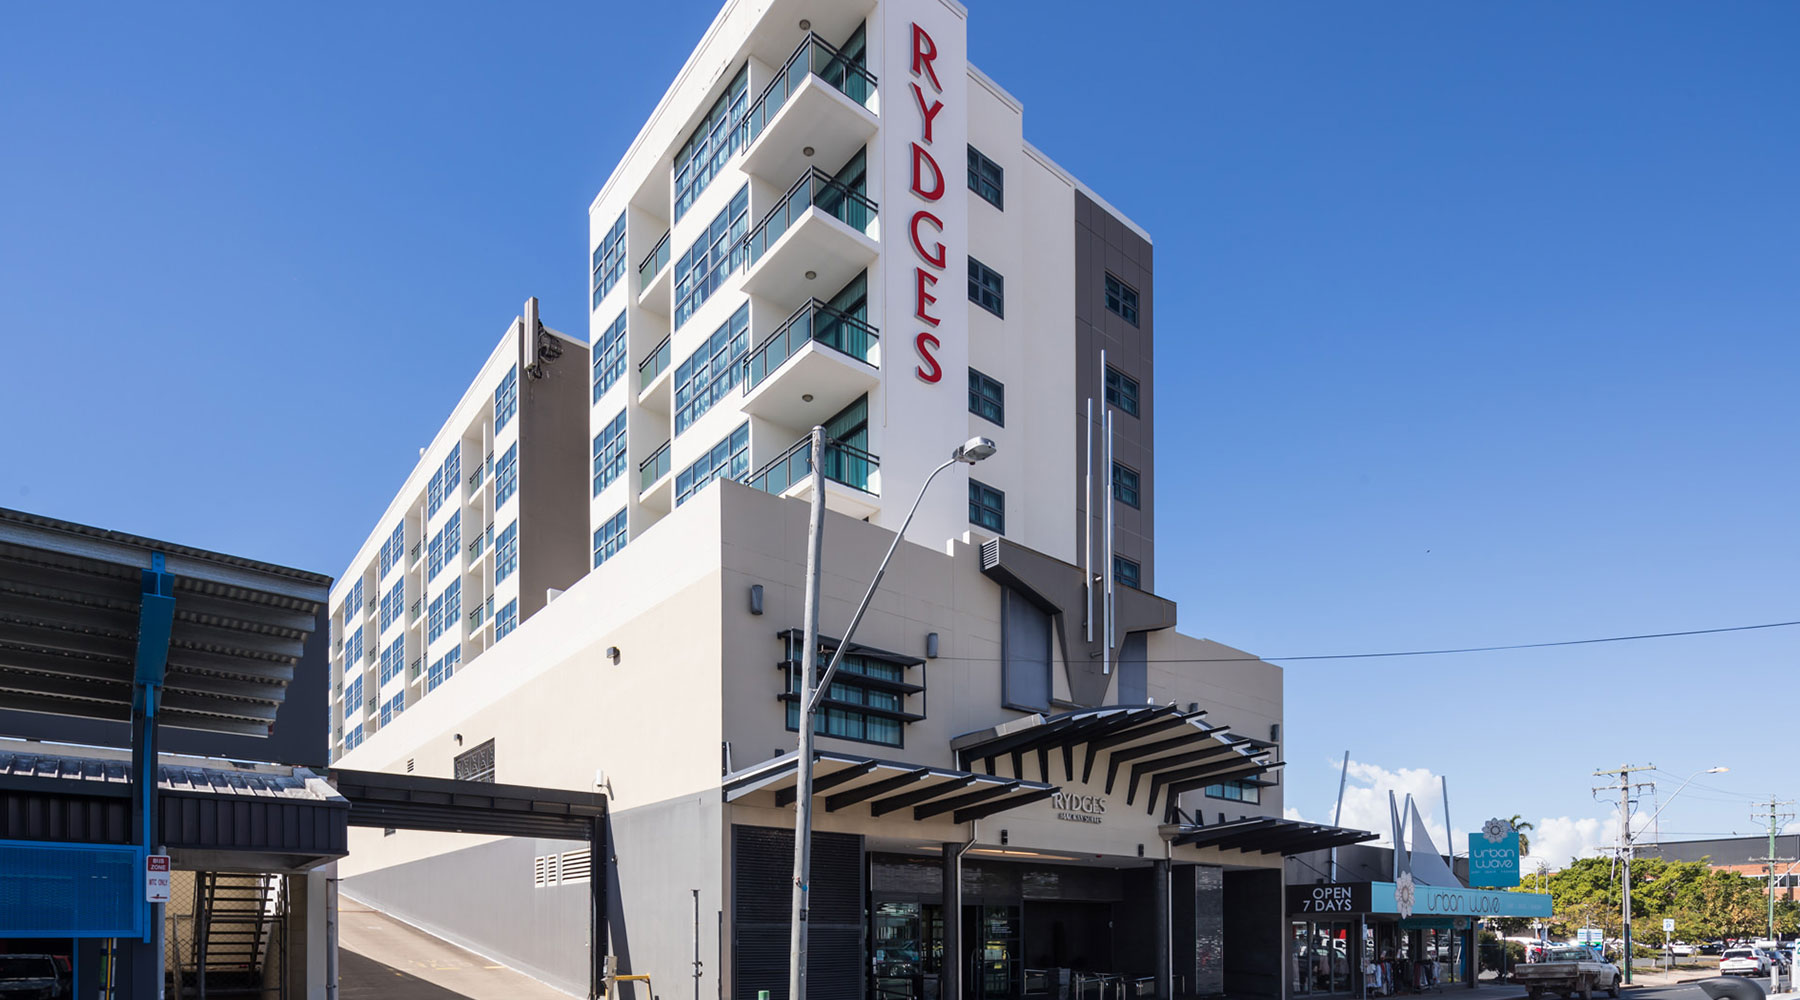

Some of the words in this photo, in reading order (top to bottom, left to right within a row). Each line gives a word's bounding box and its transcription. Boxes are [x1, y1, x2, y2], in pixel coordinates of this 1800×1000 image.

[909, 21, 946, 384] RYDGES
[1053, 792, 1107, 814] RYDGES
[1474, 848, 1514, 858] urban
[1475, 859, 1513, 868] wave
[1313, 887, 1352, 900] OPEN
[1303, 901, 1311, 912] 7
[1315, 899, 1352, 912] DAYS
[1427, 889, 1465, 912] urban
[1469, 894, 1500, 914] wave
